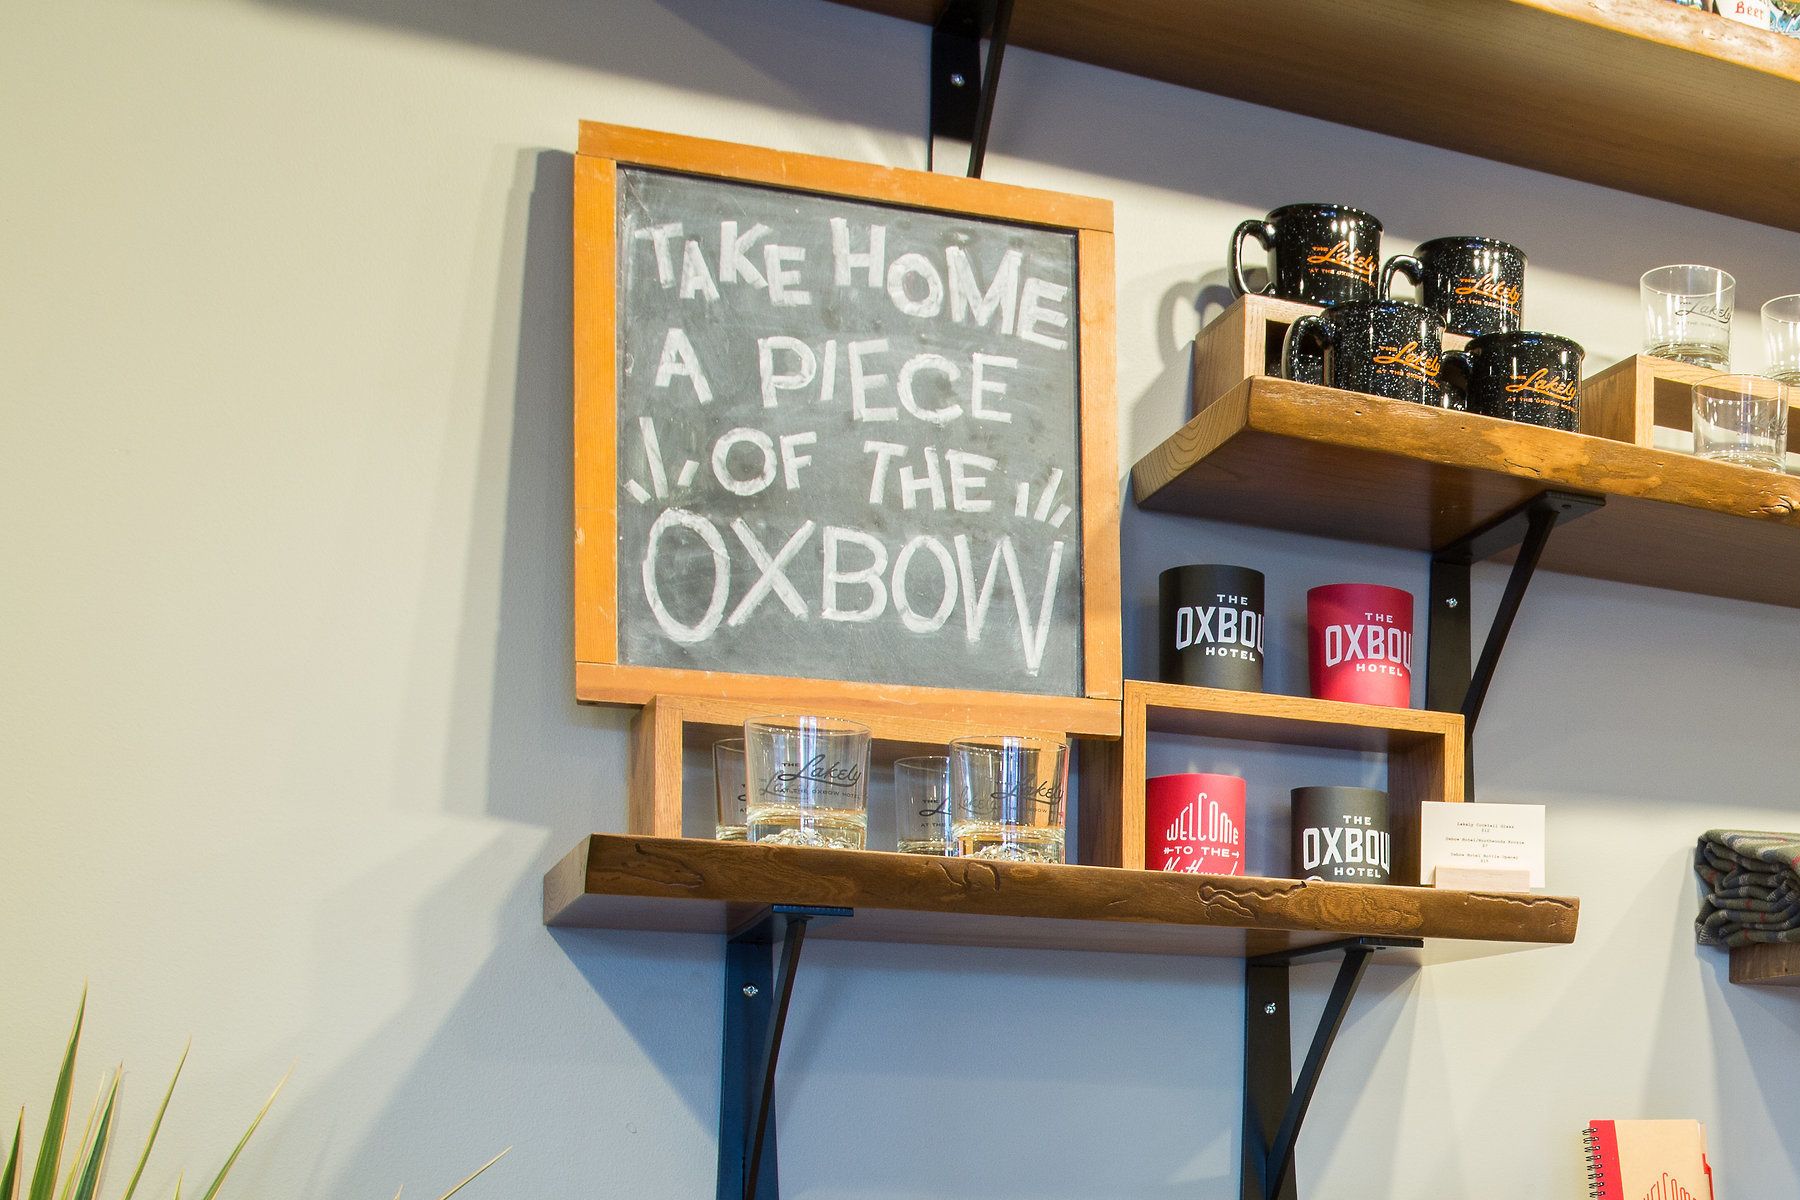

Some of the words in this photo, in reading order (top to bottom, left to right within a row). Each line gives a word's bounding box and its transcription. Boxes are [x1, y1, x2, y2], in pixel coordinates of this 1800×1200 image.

[1307, 240, 1377, 275] Lakely
[635, 221, 812, 306] TAKE
[830, 216, 1069, 350] HOME
[1373, 341, 1440, 377] Lakely
[655, 328, 713, 404] A
[757, 336, 1018, 424] PIECE
[1505, 367, 1577, 401] Lakely
[711, 427, 818, 496] OF
[863, 440, 1000, 512] THE
[642, 507, 1065, 677] OXBOW
[1216, 593, 1248, 606] THE
[1365, 612, 1393, 623] THE
[1205, 647, 1256, 662] HOTEL
[1356, 663, 1403, 677] HOTEL
[778, 754, 862, 787] Lakely
[1166, 792, 1239, 845] WELCOME
[1343, 815, 1371, 826] THE
[1174, 846, 1194, 855] TO
[1201, 846, 1230, 858] THE
[1334, 866, 1381, 879] HOTEL
